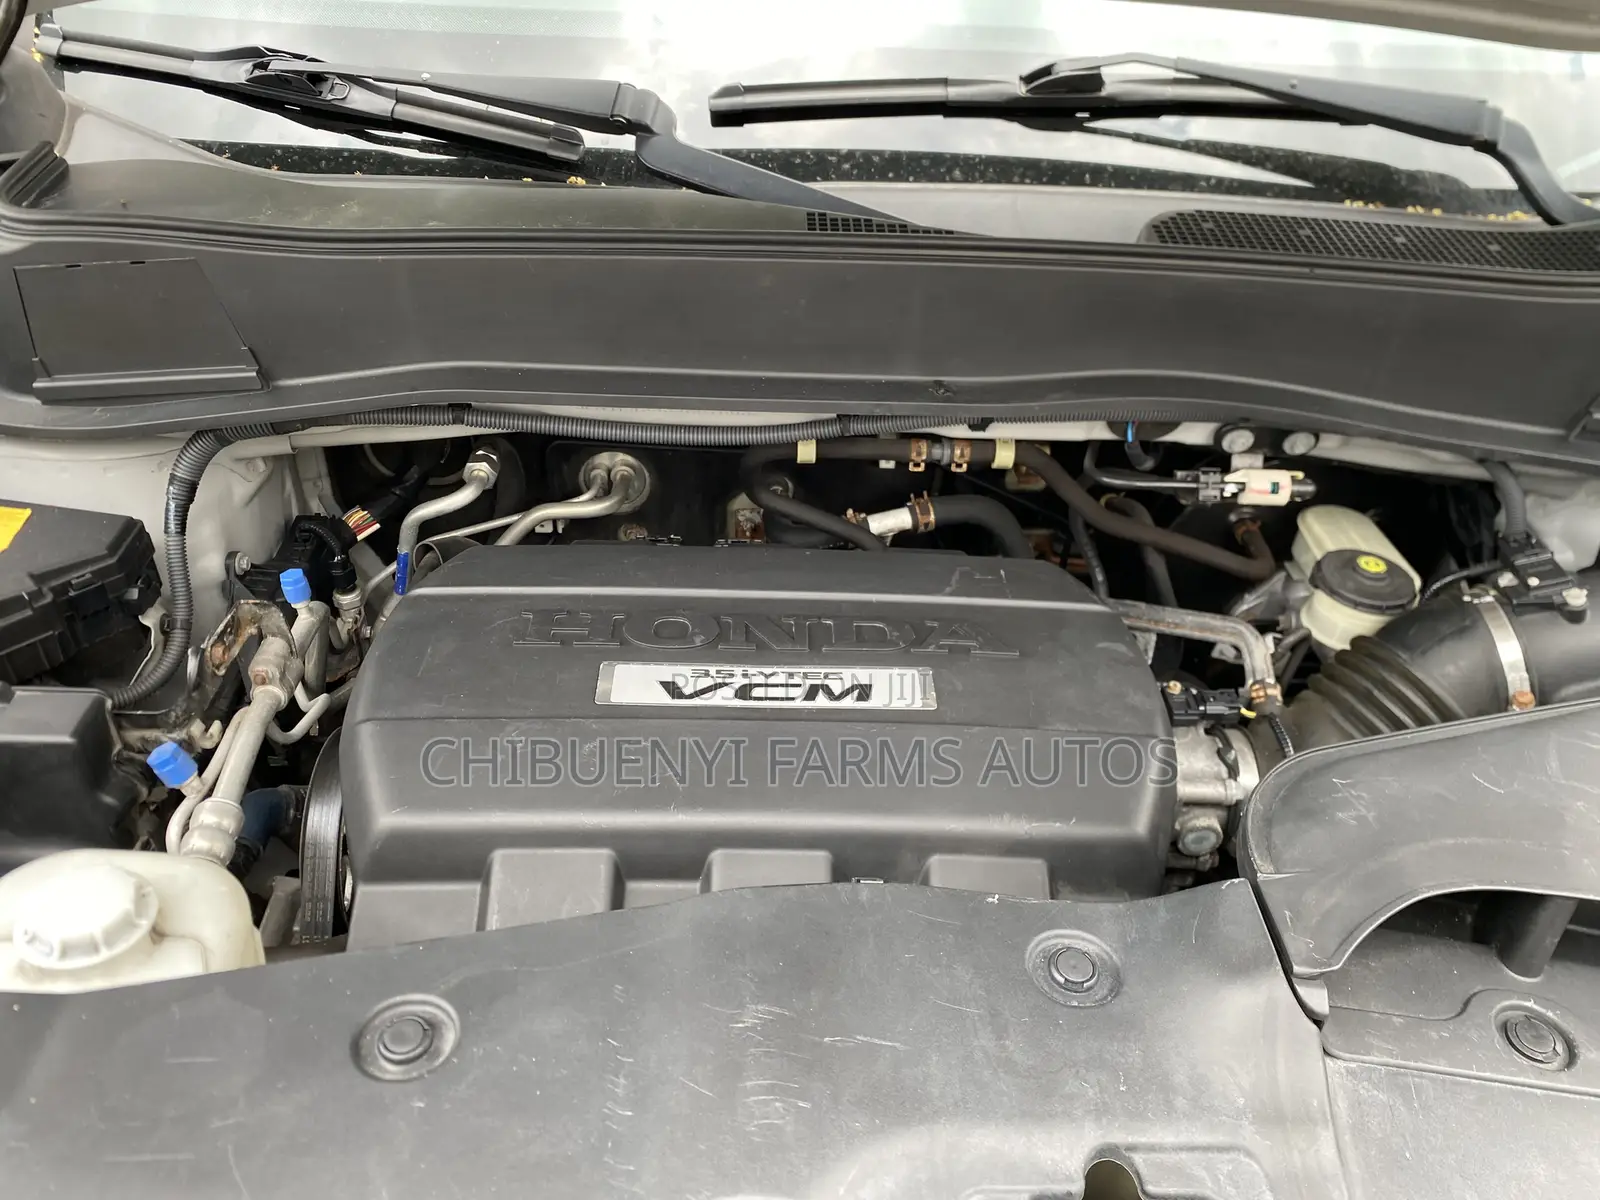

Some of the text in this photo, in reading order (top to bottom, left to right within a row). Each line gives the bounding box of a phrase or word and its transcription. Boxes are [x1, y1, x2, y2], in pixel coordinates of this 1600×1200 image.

[513, 609, 1020, 655] HONDA
[690, 668, 735, 679] 3.5
[657, 680, 873, 703] VCM
